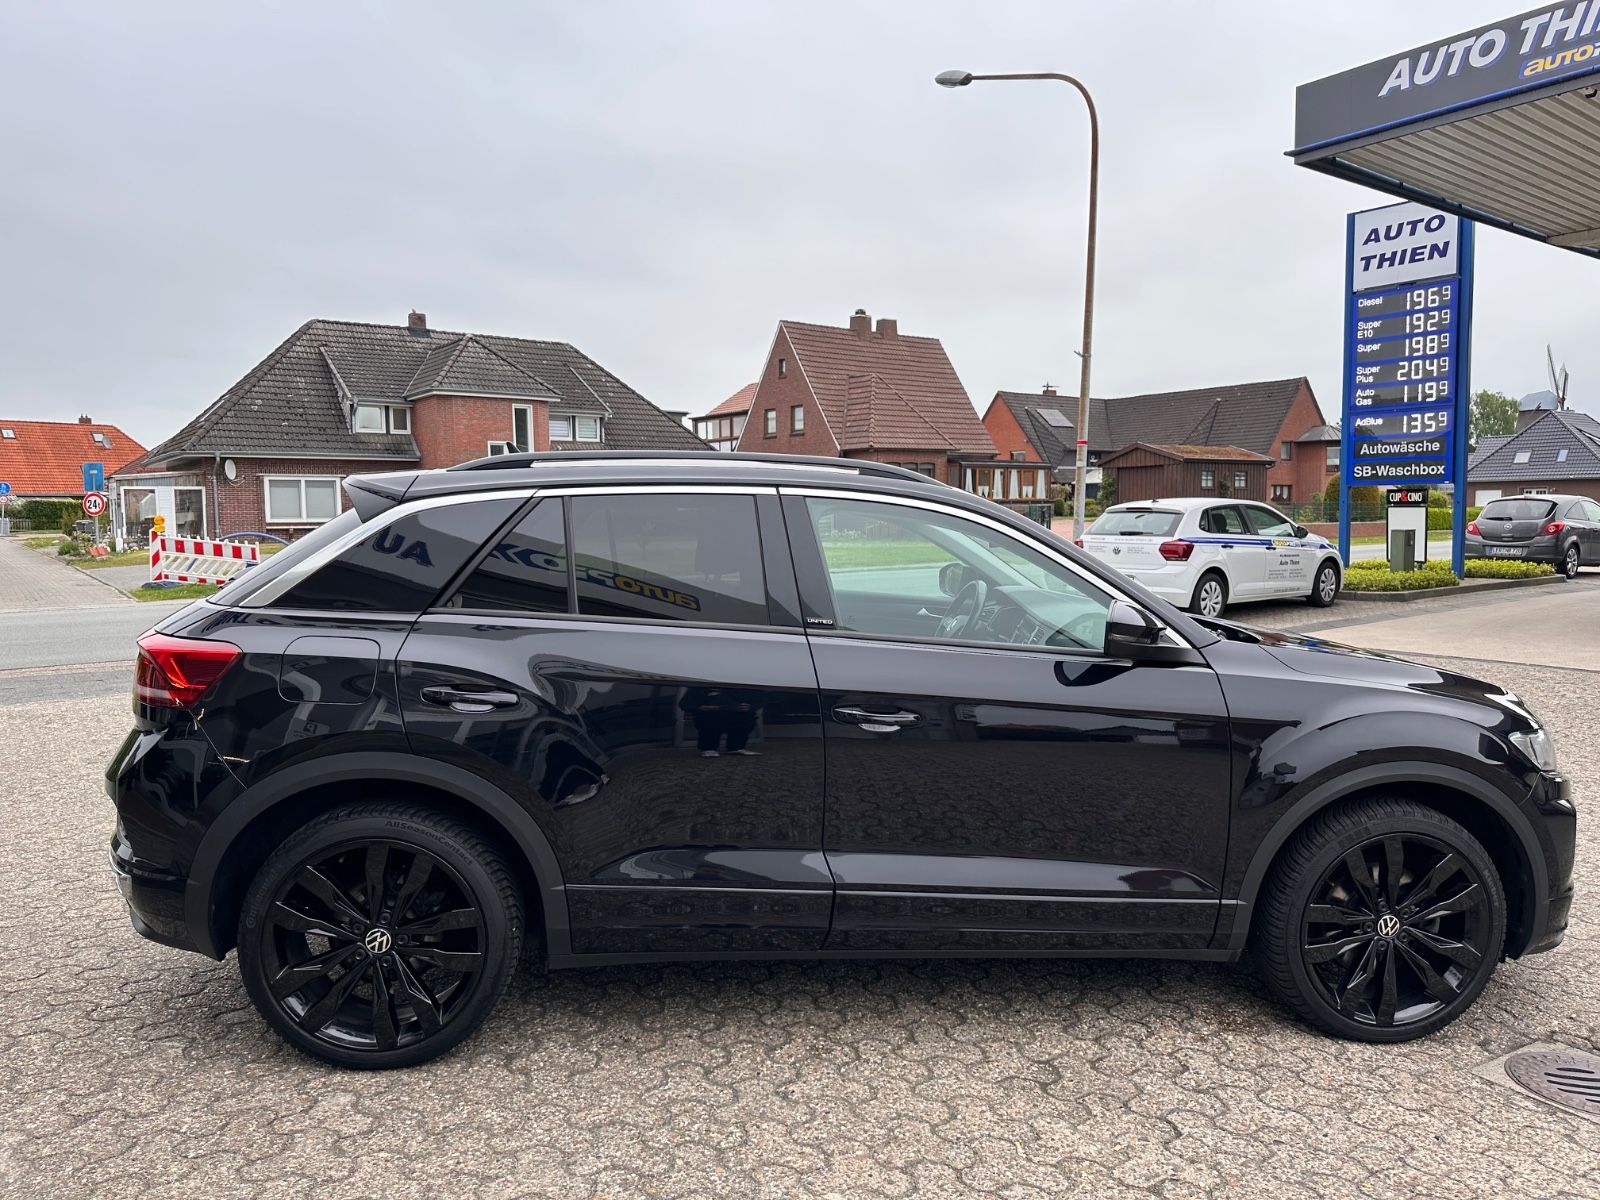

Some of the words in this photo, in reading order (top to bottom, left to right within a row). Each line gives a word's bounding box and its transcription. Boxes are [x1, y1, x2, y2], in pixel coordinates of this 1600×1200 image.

[1377, 28, 1508, 98] AUTO
[1519, 0, 1600, 55] THI
[1362, 214, 1446, 246] AUTO
[1360, 240, 1450, 272] THIEN
[1358, 296, 1383, 308] Diesel
[1357, 320, 1382, 332] Super
[1357, 330, 1374, 339] E10
[1356, 343, 1382, 353] Super
[1356, 364, 1381, 375] Super
[1356, 375, 1374, 384] Plus
[1355, 388, 1375, 397] Auto
[1355, 398, 1372, 406] Gas
[1355, 417, 1384, 427] AdBlue
[1360, 440, 1440, 455] Autowäsche
[1353, 464, 1445, 478] SB-Waschbox
